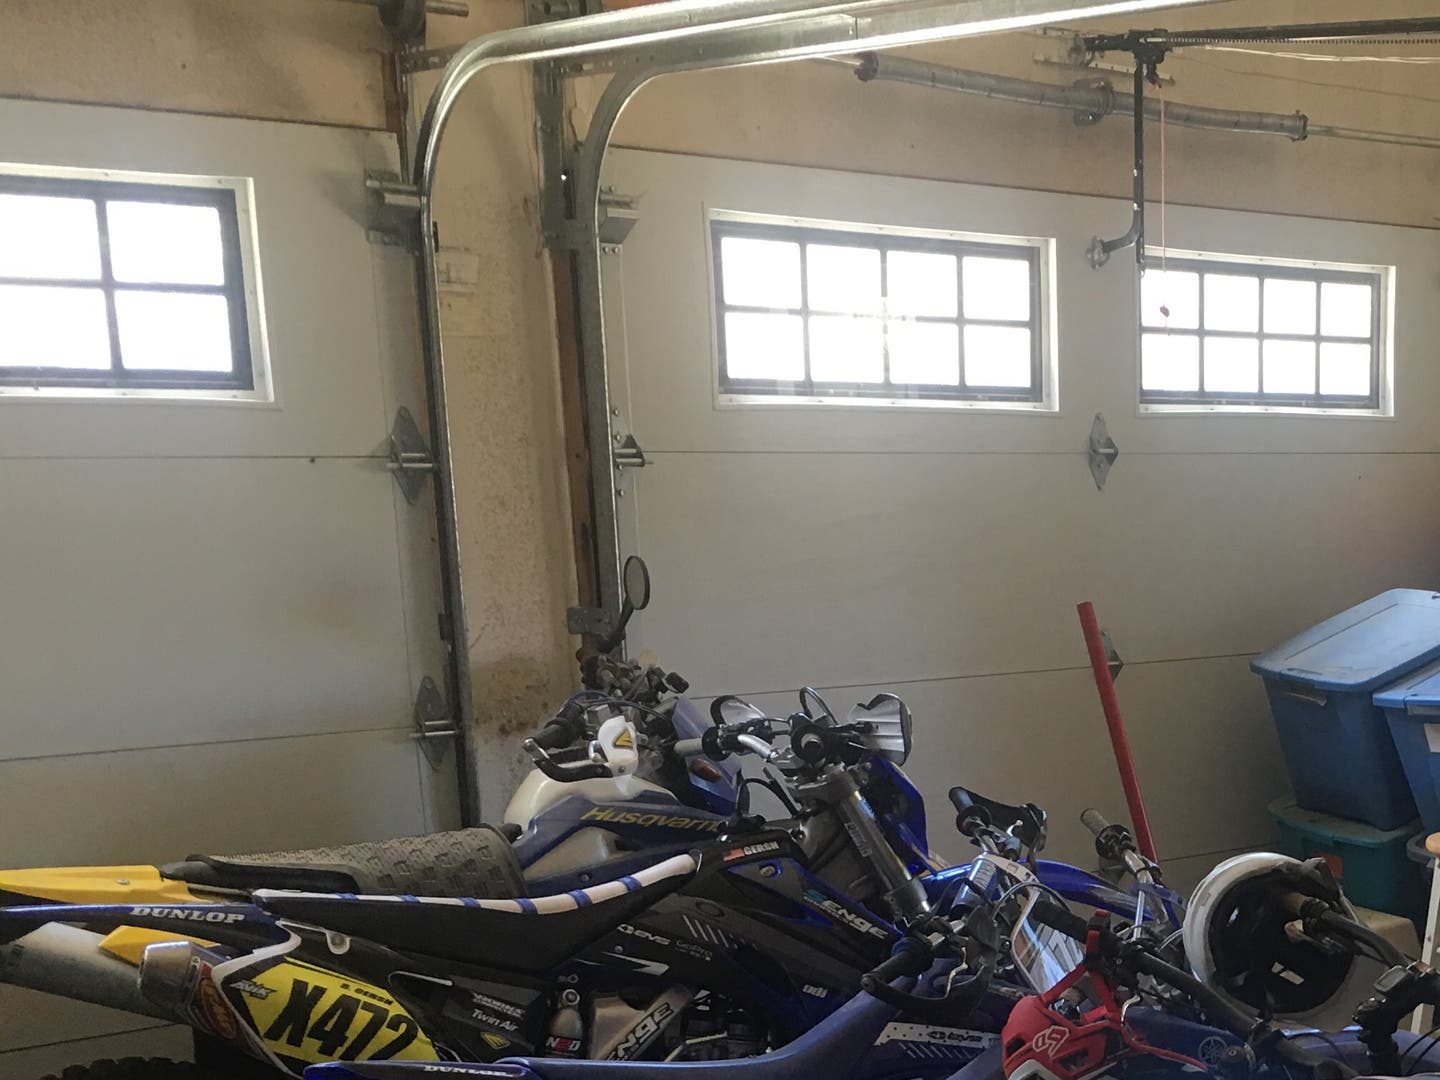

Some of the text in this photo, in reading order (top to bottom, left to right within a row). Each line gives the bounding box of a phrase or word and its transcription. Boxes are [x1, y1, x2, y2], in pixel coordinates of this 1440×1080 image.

[129, 906, 246, 925] DUNLOP
[263, 978, 419, 1062] X472
[472, 1007, 501, 1028] Twin
